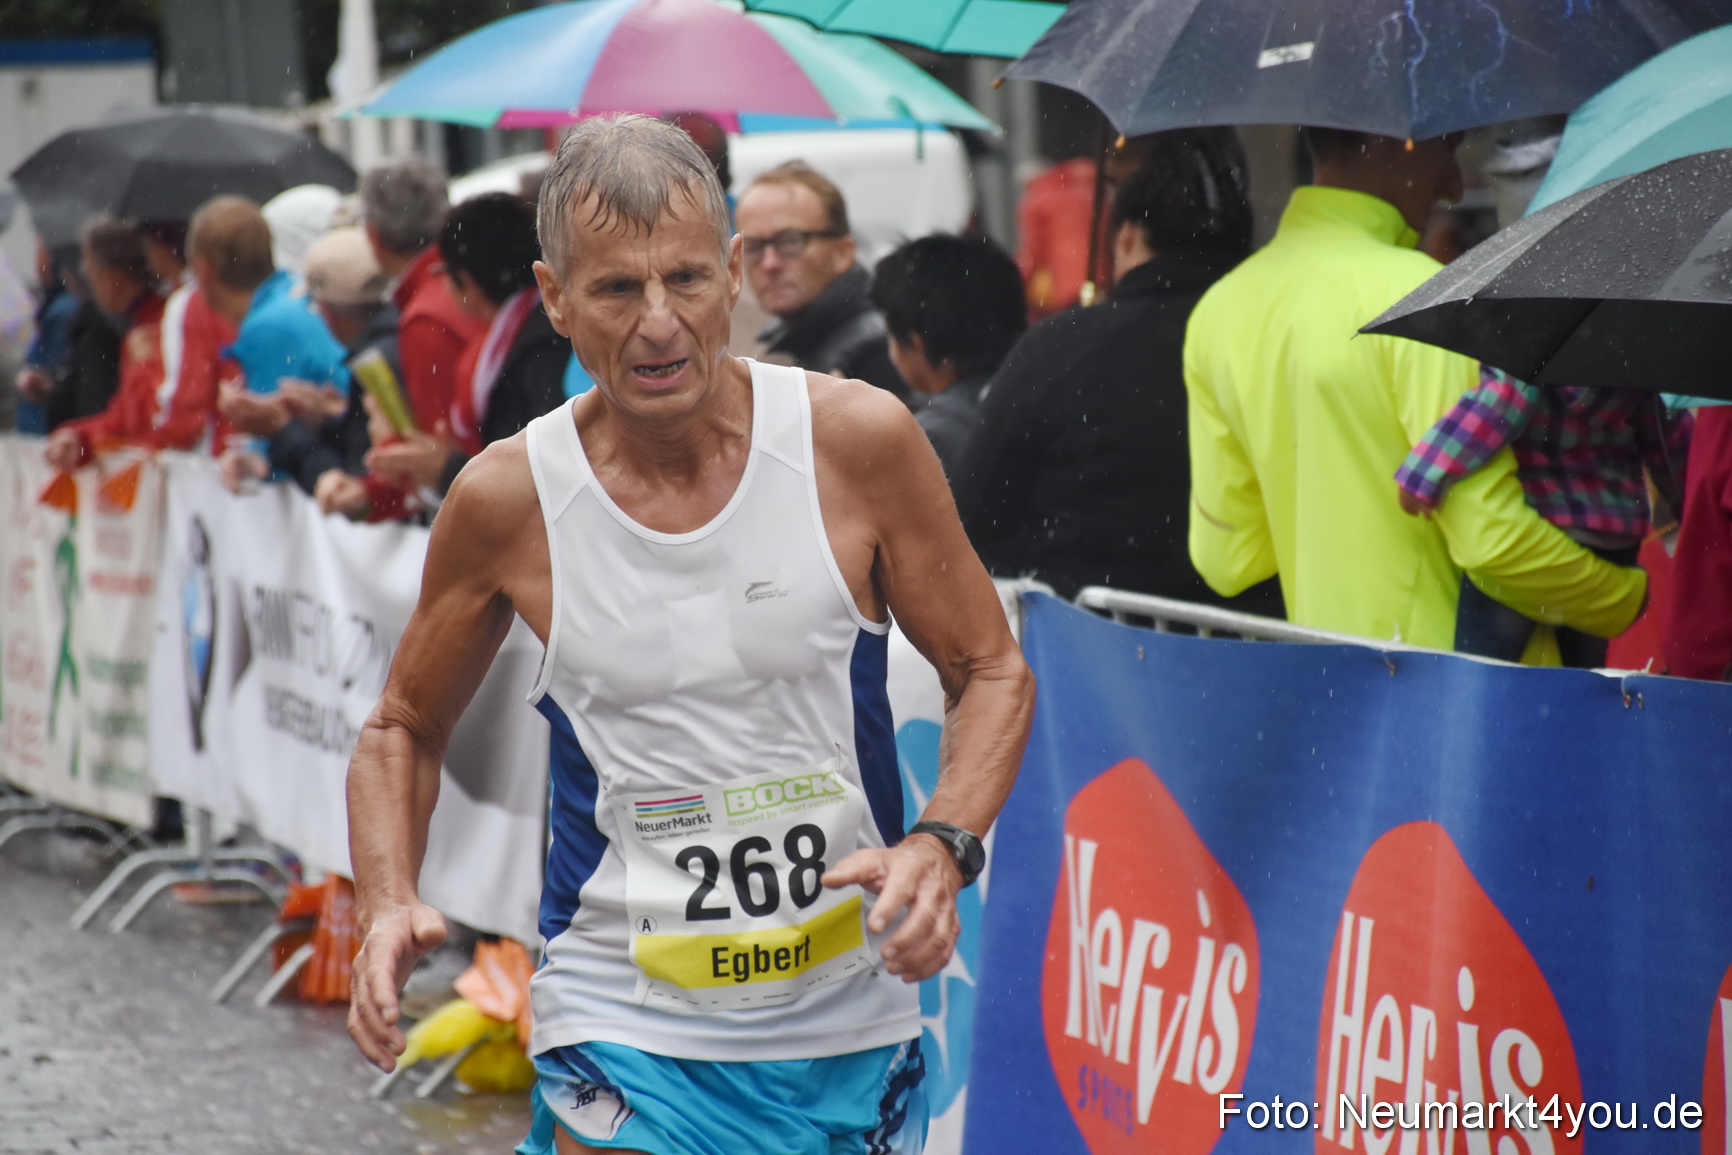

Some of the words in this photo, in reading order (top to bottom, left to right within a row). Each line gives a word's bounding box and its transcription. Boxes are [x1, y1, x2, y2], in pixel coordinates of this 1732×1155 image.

[723, 770, 846, 817] BOCK
[728, 811, 765, 827] inspired
[767, 809, 777, 820] by
[779, 803, 806, 815] smart
[634, 812, 712, 833] NeuerMarkt
[675, 823, 826, 921] 268
[711, 935, 811, 983] Egbert
[1064, 833, 1248, 1125] Hervis
